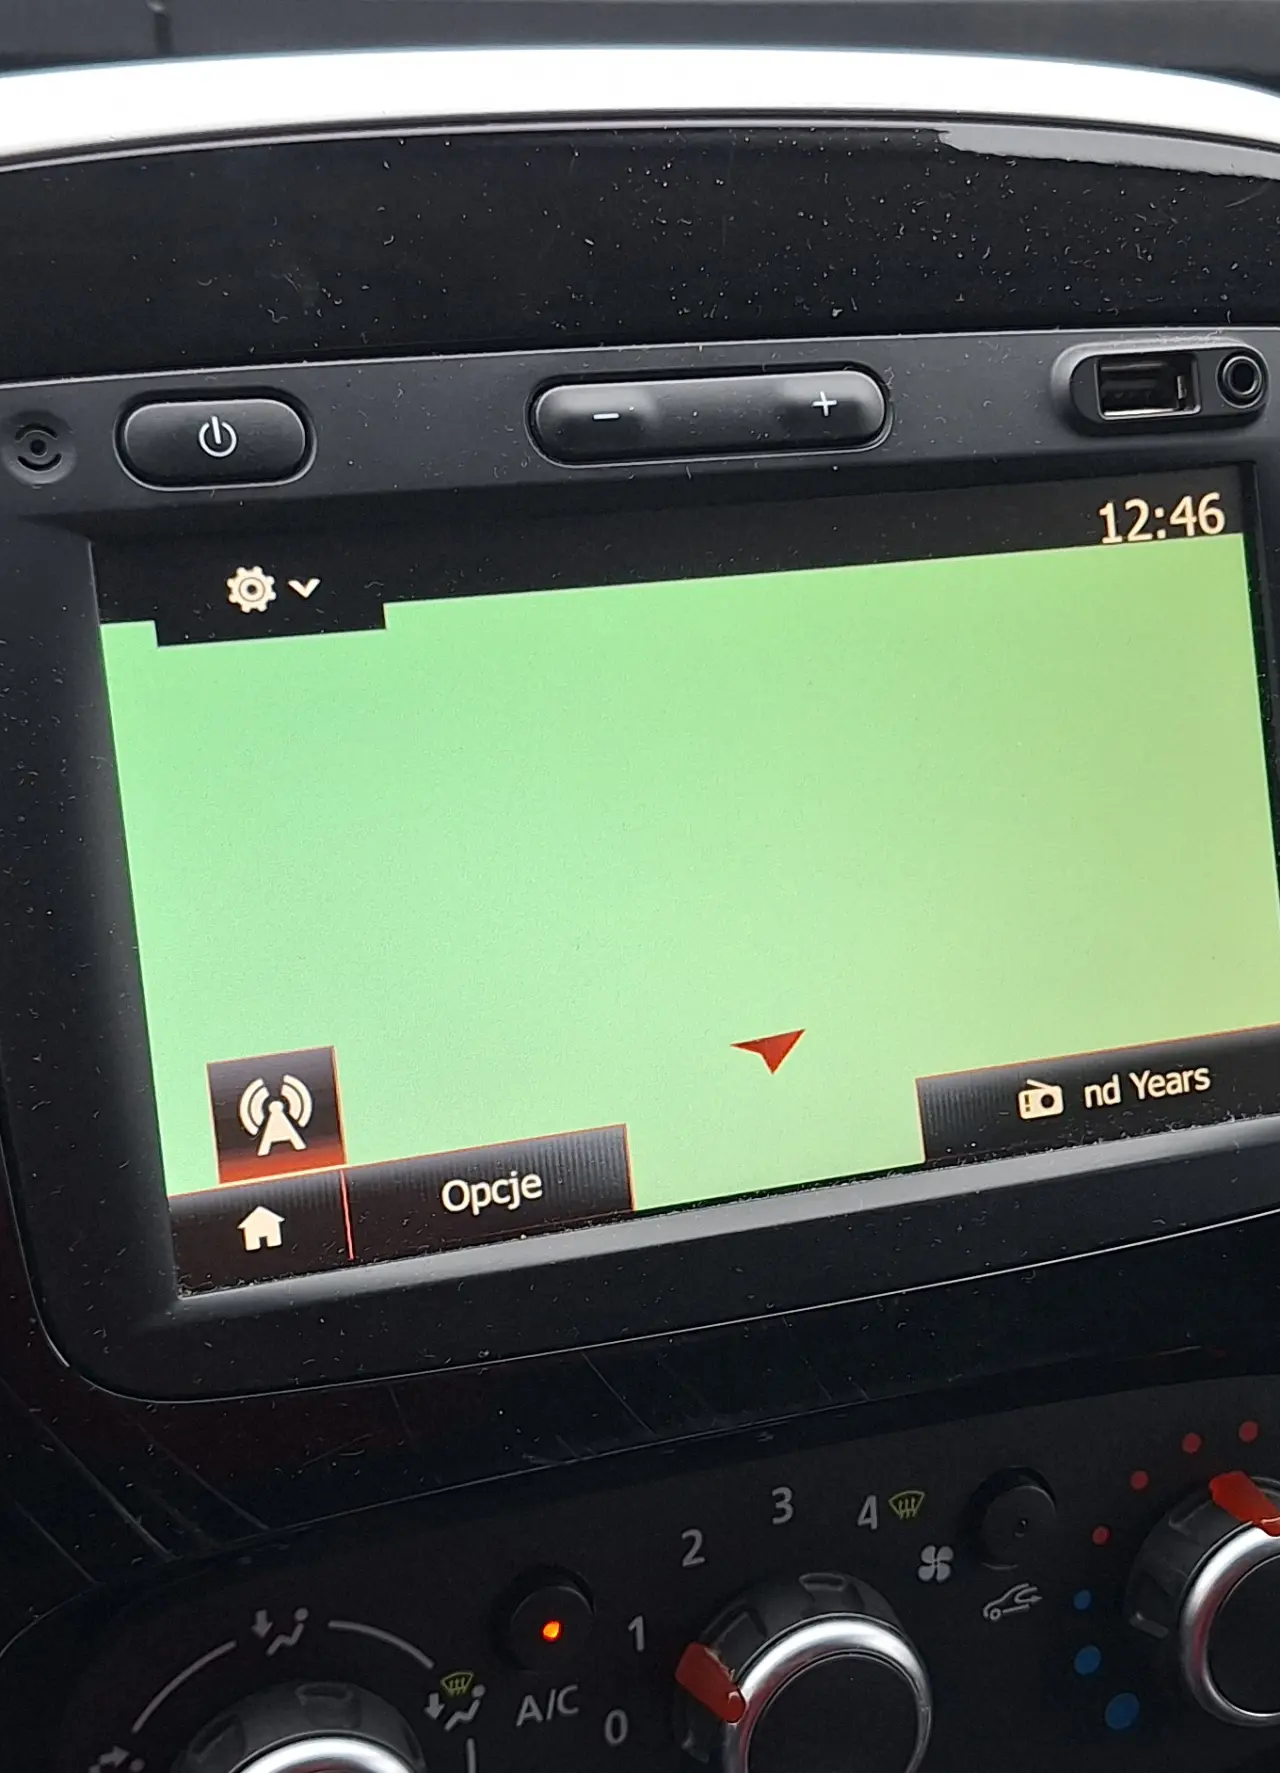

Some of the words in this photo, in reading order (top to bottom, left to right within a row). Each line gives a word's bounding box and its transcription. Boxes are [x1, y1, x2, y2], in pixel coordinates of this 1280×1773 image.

[1098, 492, 1226, 544] 12:46
[1083, 1074, 1121, 1108] nd
[1129, 1066, 1212, 1101] Years
[441, 1170, 543, 1216] Opcje
[771, 1487, 793, 1524] 3
[857, 1495, 878, 1530] 4
[681, 1529, 705, 1567] 2
[628, 1615, 646, 1651] 1
[516, 1684, 580, 1726] A/C
[604, 1709, 628, 1746] 0
